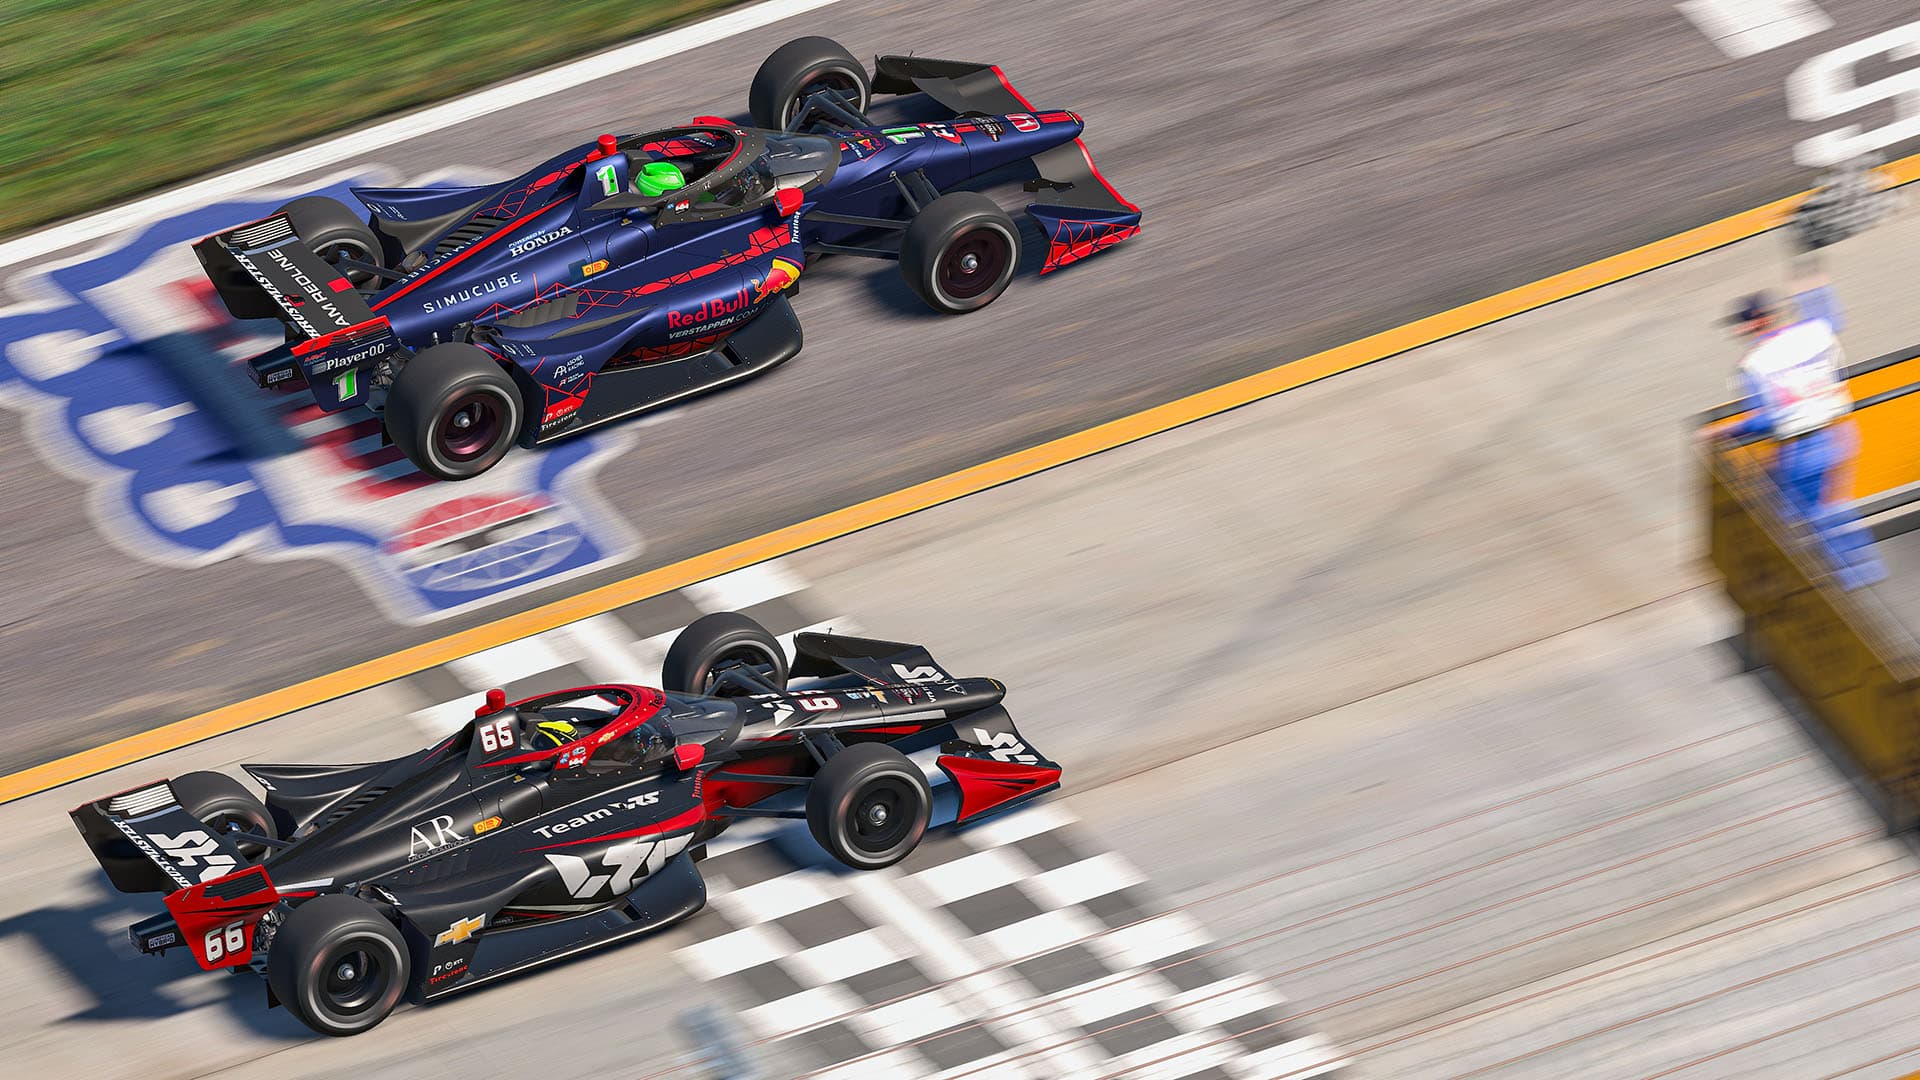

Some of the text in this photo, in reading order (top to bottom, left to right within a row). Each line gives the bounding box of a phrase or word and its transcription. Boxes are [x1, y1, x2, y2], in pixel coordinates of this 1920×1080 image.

[594, 164, 619, 197] 1
[510, 226, 573, 258] HONDA
[233, 252, 322, 339] HRUSTMASTER
[267, 248, 351, 326] AM REDLINE
[423, 272, 522, 314] SIMUCUBE
[667, 287, 749, 329] Red Bull
[332, 367, 358, 402] 1
[541, 411, 577, 431] Firestone
[479, 720, 514, 753] 66
[409, 815, 466, 857] AR
[532, 808, 613, 839] Team
[204, 920, 245, 962] 66
[428, 964, 469, 985] Firestone
